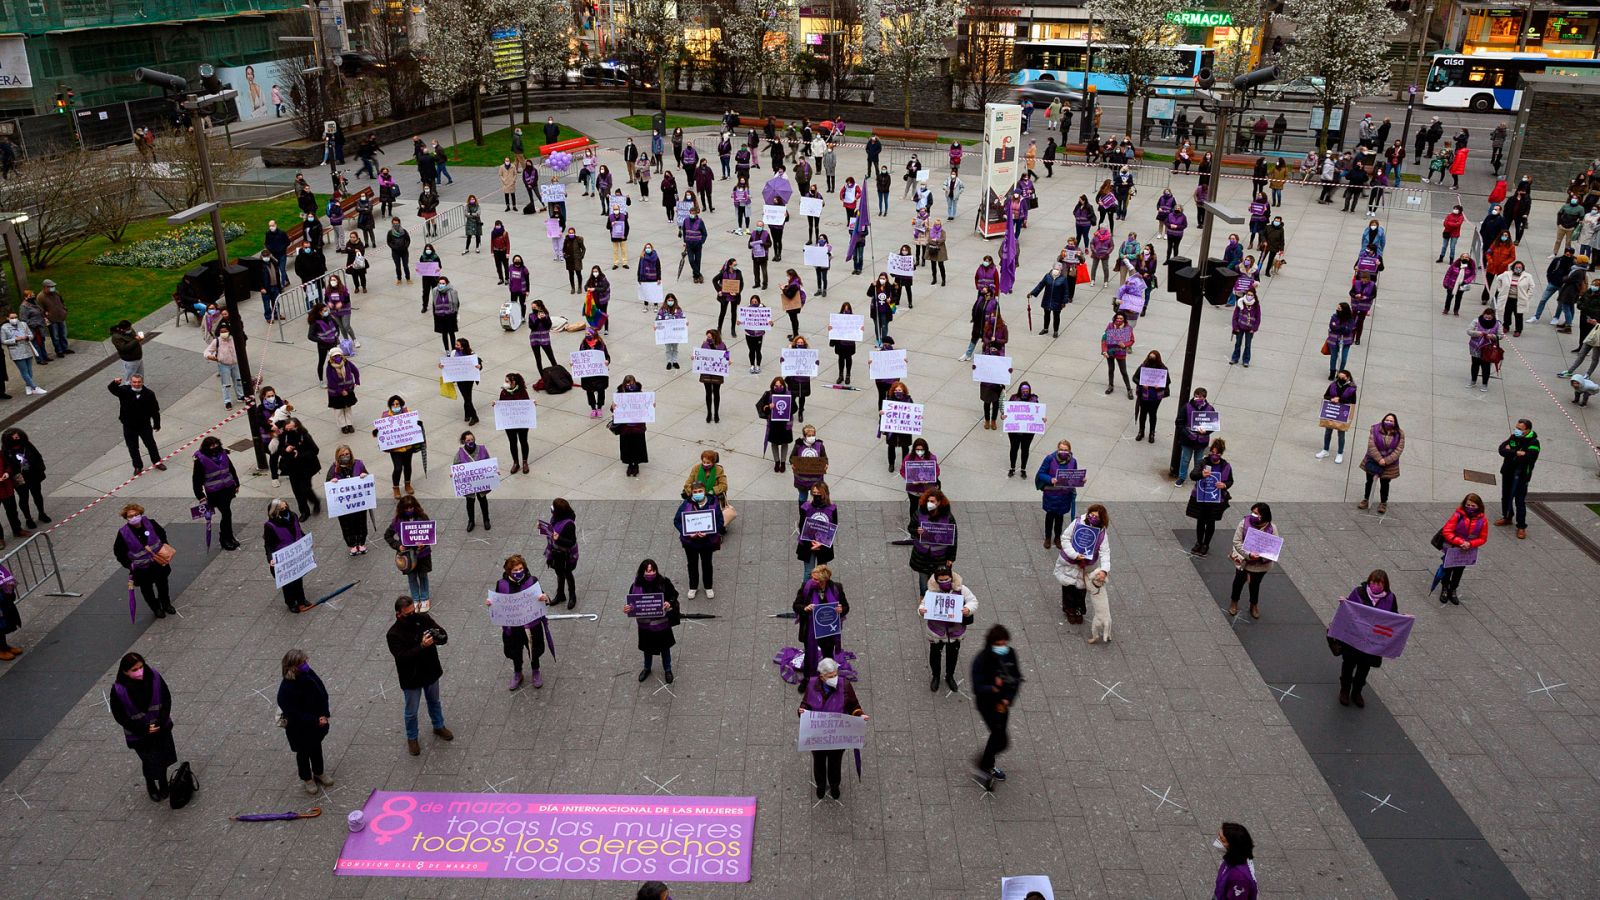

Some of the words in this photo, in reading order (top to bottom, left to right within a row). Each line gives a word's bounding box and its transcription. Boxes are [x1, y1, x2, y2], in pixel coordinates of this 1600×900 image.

[1166, 13, 1232, 25] FARMACIA
[1444, 58, 1464, 66] alsa
[886, 411, 911, 419] GRITO
[452, 464, 465, 472] NO
[454, 465, 497, 479] APARECEMOS
[456, 483, 472, 491] NOS
[420, 802, 443, 813] de
[448, 801, 523, 814] marzo
[539, 804, 558, 812] DÍA
[562, 805, 652, 814] INTERNACIONAL
[447, 815, 541, 835] todas
[550, 816, 593, 836] las
[613, 819, 742, 841] mujeres
[411, 831, 506, 853] todos
[515, 832, 559, 853] los
[579, 835, 741, 857] derechos
[504, 852, 600, 873] todos
[613, 853, 657, 874] los
[669, 853, 739, 875] días
